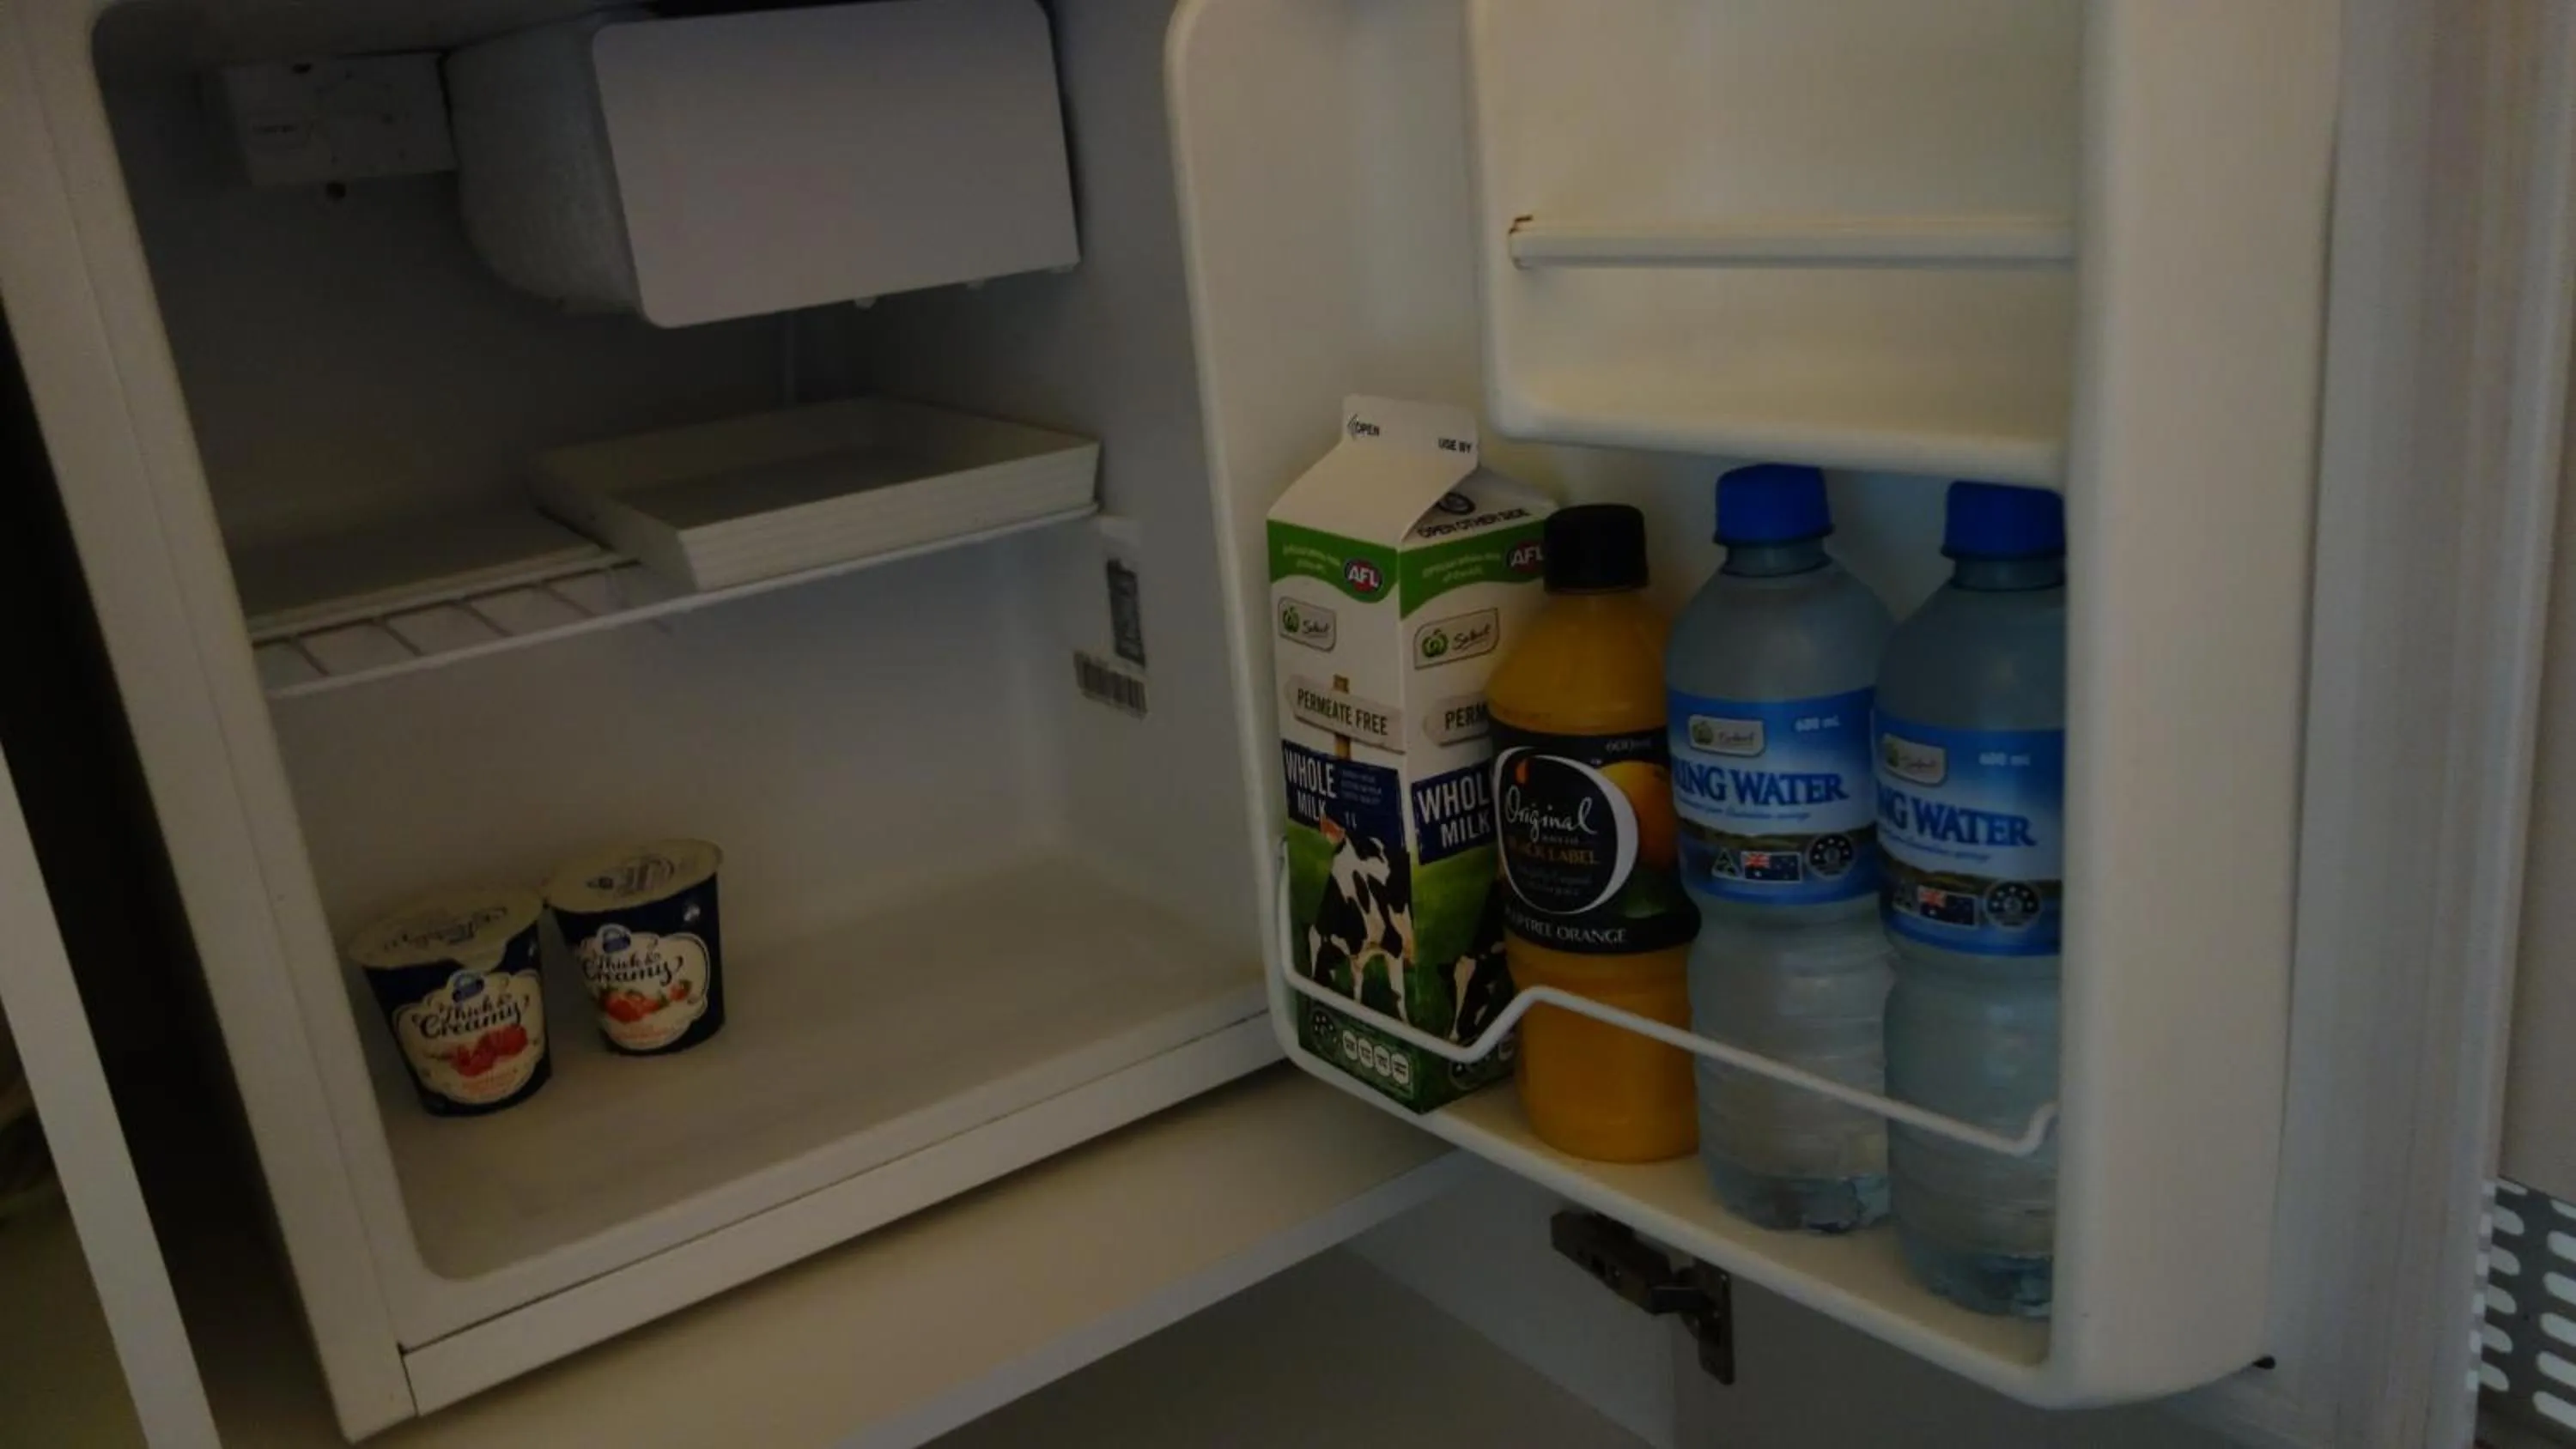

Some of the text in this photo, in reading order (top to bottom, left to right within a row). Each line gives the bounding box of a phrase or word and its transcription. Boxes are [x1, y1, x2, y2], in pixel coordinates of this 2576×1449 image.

[1354, 421, 1380, 437] OPEN
[1438, 438, 1473, 454] USE BY
[1417, 522, 1456, 538] OPEN
[1510, 545, 1544, 568] AFL
[1346, 566, 1379, 588] AFL
[1302, 619, 1329, 635] Select
[1453, 624, 1492, 650] Select
[1297, 688, 1388, 736] PERMEATE FREE
[1285, 746, 1338, 799] WHOLE
[1729, 768, 1850, 806] WATER
[1297, 790, 1327, 822] MILK
[1505, 784, 1598, 843] Original
[1440, 810, 1492, 849] MILK
[1911, 797, 2037, 847] WATER
[1548, 846, 1601, 866] LABEL
[1556, 925, 1627, 945] ORANGE
[582, 955, 683, 987] Creamy
[594, 950, 640, 971] Thick
[412, 994, 530, 1039] Creamy
[440, 995, 493, 1022] Thick
